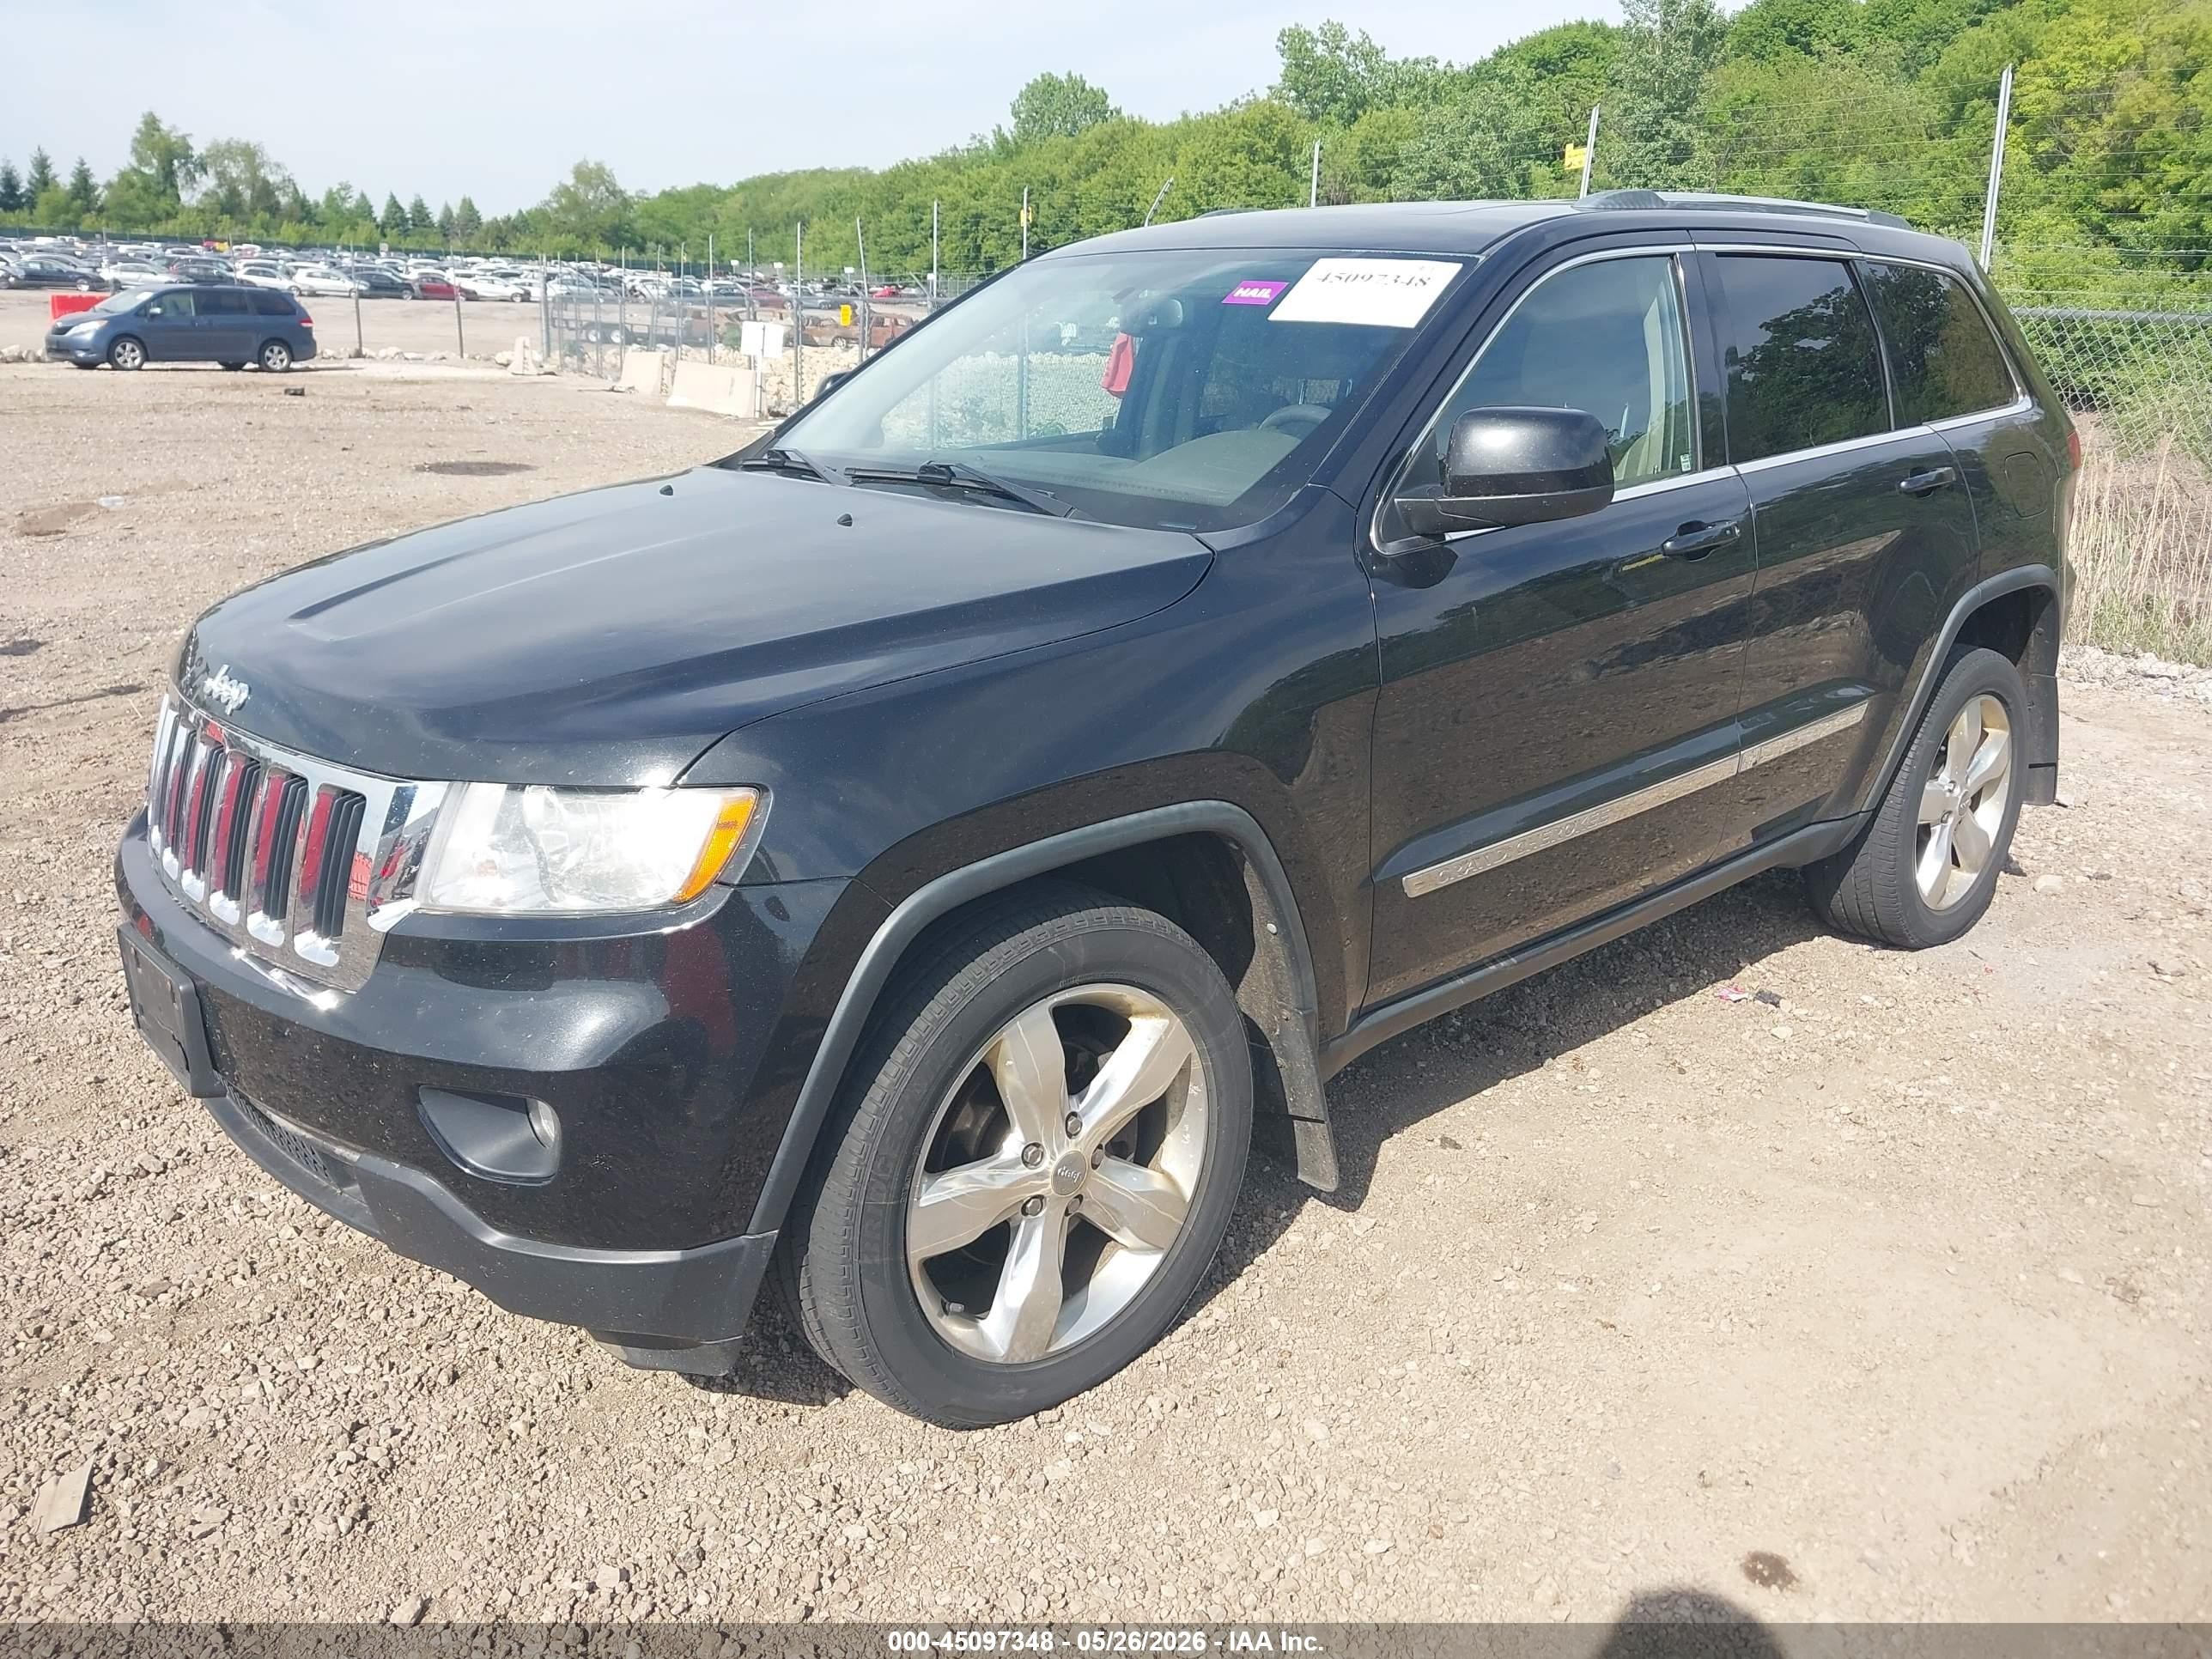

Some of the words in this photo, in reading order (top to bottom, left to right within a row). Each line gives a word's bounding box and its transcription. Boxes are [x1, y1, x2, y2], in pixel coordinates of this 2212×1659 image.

[1233, 287, 1273, 299] HAIL
[1316, 271, 1431, 289] 45097348
[203, 664, 249, 715] Jeep
[1437, 848, 1510, 884] GRAND
[1516, 809, 1611, 854] CHEROKEE
